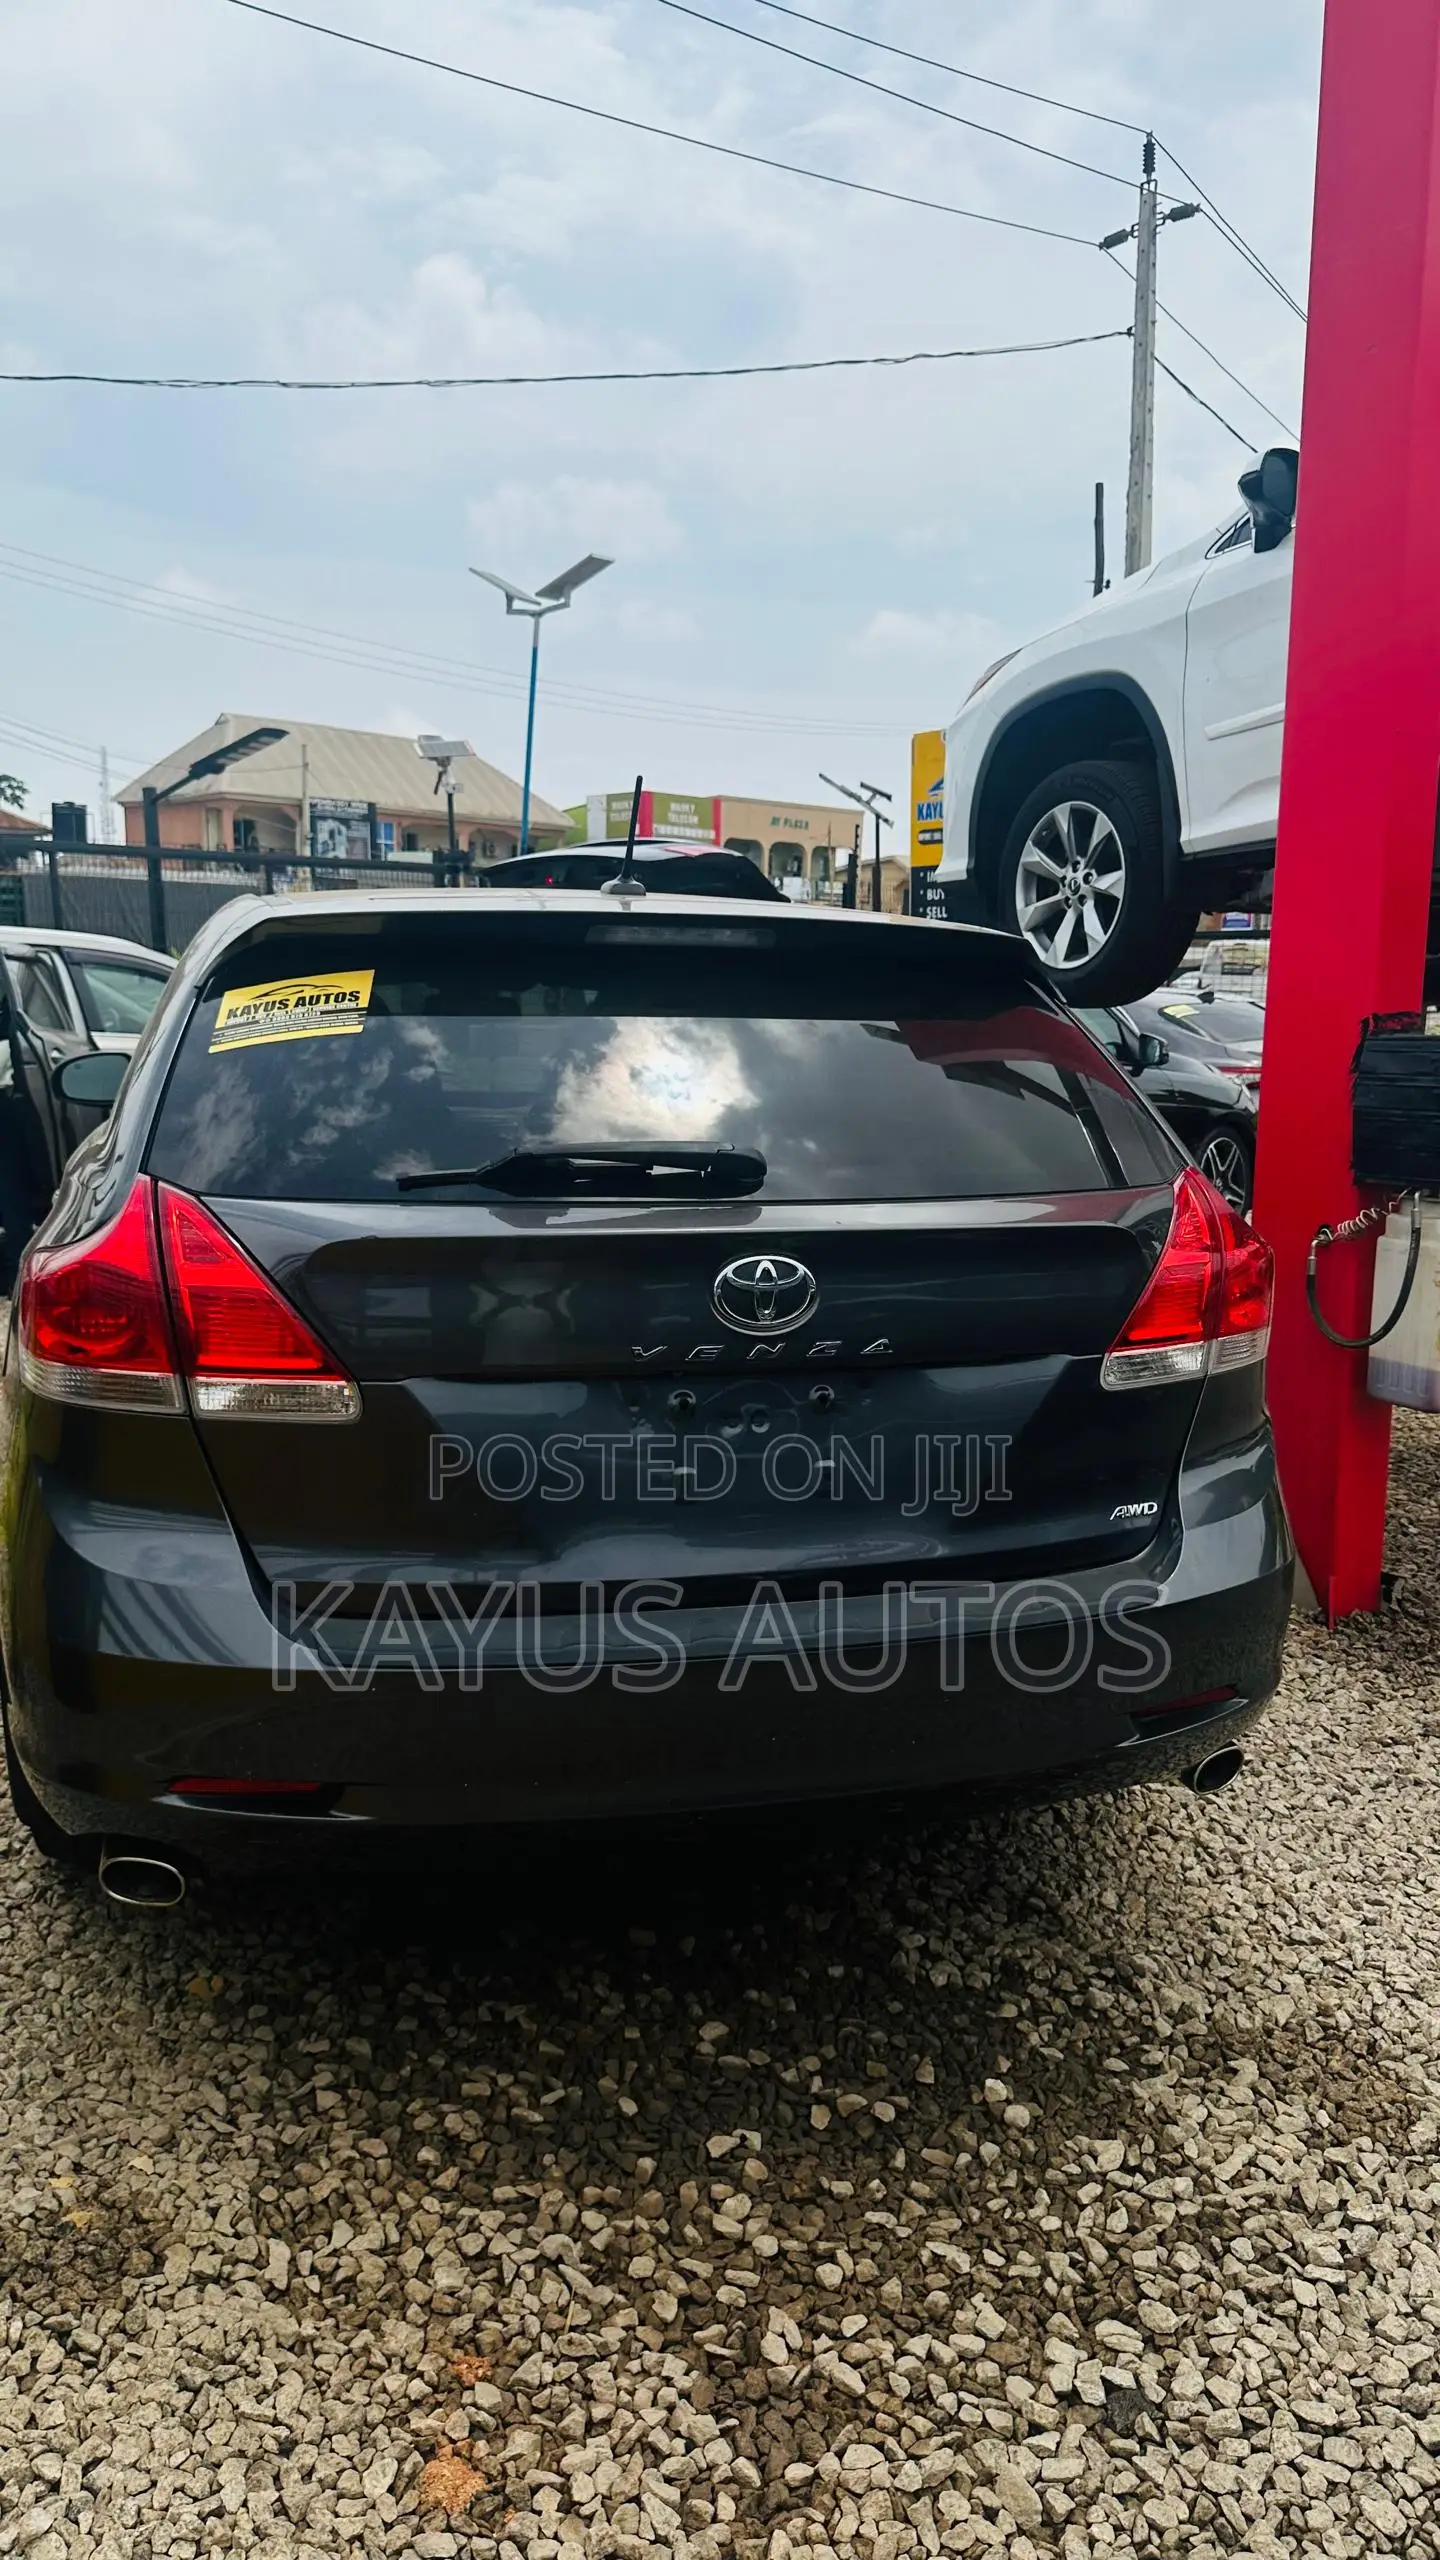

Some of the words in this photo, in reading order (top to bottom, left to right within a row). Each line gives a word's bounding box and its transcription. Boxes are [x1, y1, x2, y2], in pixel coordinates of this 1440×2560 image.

[926, 905, 948, 919] SELL
[227, 998, 290, 1020] KAYUS
[294, 990, 361, 1008] AUTOS
[630, 1338, 894, 1362] VENZA
[1109, 1501, 1158, 1522] AWD
